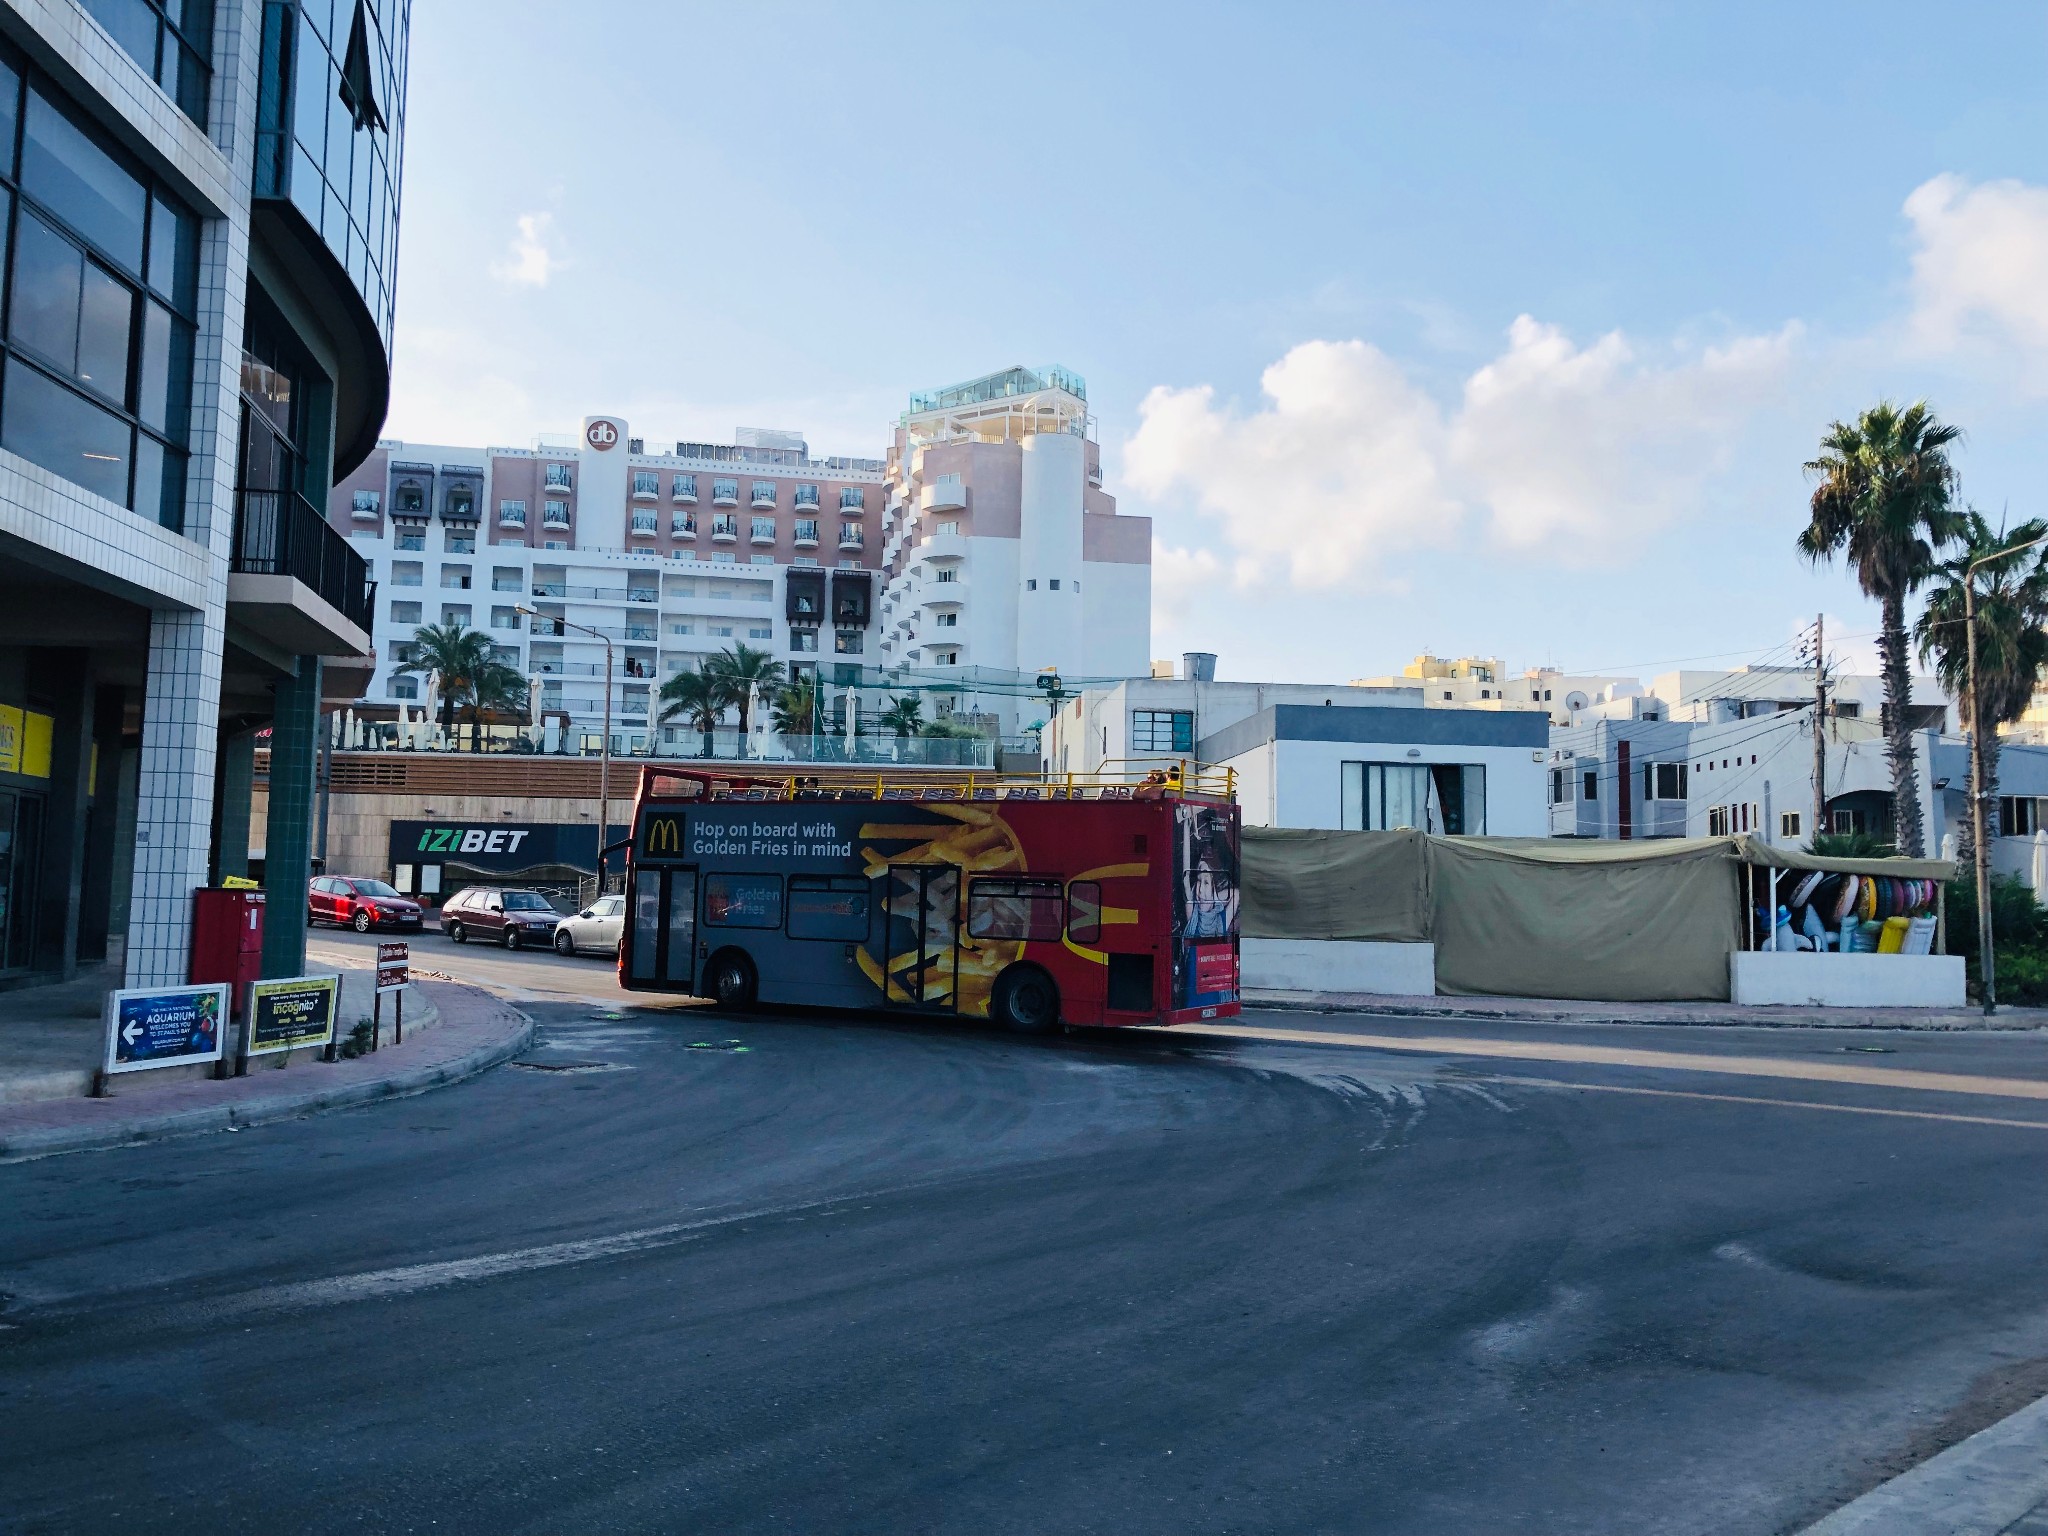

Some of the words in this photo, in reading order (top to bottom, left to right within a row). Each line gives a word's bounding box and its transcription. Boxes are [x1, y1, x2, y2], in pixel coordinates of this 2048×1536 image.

[589, 423, 616, 443] db
[694, 821, 725, 839] Hop
[729, 825, 748, 837] on
[752, 821, 797, 837] board
[803, 822, 836, 838] with
[693, 840, 746, 855] Golden
[751, 840, 788, 856] Fries
[793, 841, 807, 856] in
[812, 841, 852, 857] mind
[736, 887, 780, 901] Golden
[146, 1011, 195, 1024] AQUARIUM
[150, 1022, 180, 1031] WELCOMES
